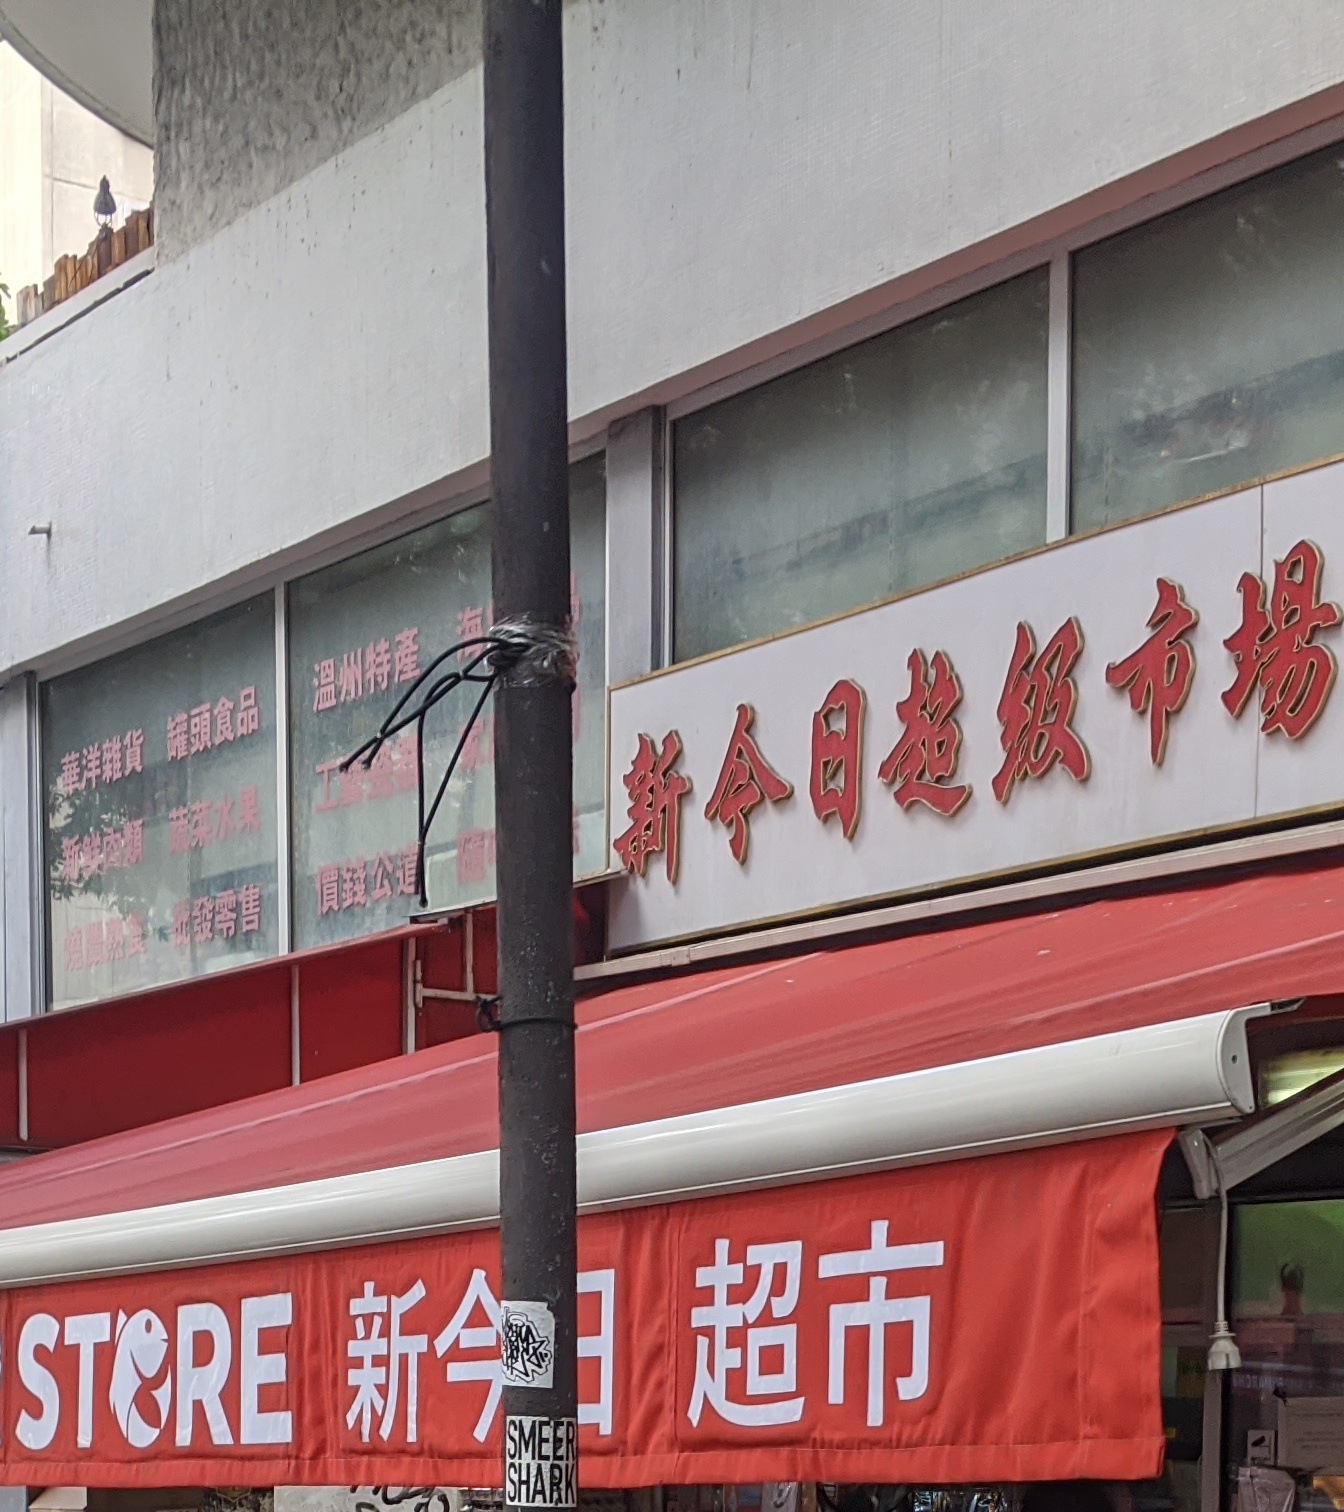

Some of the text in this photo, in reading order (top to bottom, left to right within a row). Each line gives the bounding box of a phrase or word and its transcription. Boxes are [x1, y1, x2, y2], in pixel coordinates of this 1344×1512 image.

[167, 685, 260, 762] 罐頭食品
[507, 1419, 575, 1461] SMEER
[507, 1462, 575, 1505] SHARK
